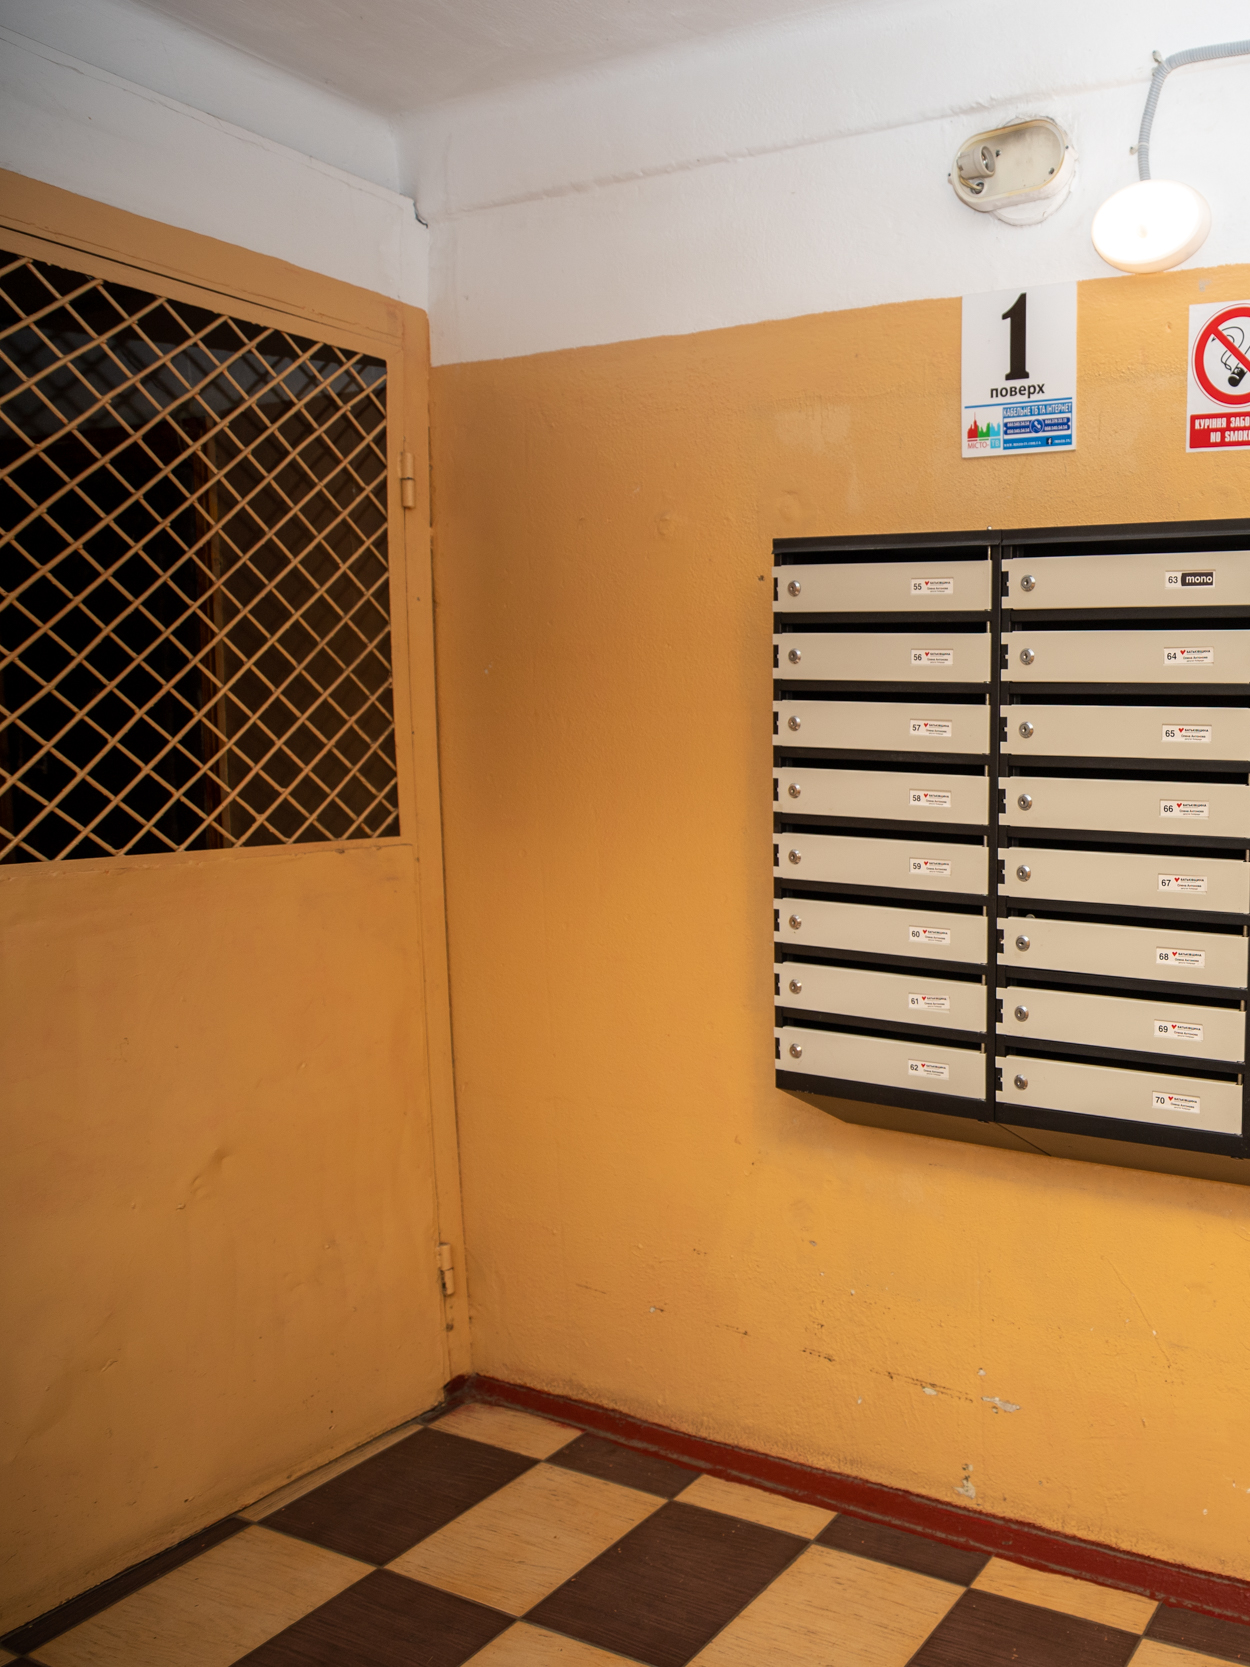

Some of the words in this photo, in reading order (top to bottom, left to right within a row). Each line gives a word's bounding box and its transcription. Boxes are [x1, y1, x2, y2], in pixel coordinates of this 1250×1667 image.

[1002, 292, 1029, 380] 1
[990, 383, 1045, 398] поверх
[1004, 407, 1030, 416] КАБЕЛЬНЕ
[1039, 405, 1045, 413] ТА
[1046, 403, 1071, 413] ІНТЕРНЕТ
[1195, 418, 1226, 429] КУРІННЯ
[1210, 432, 1220, 442] NO
